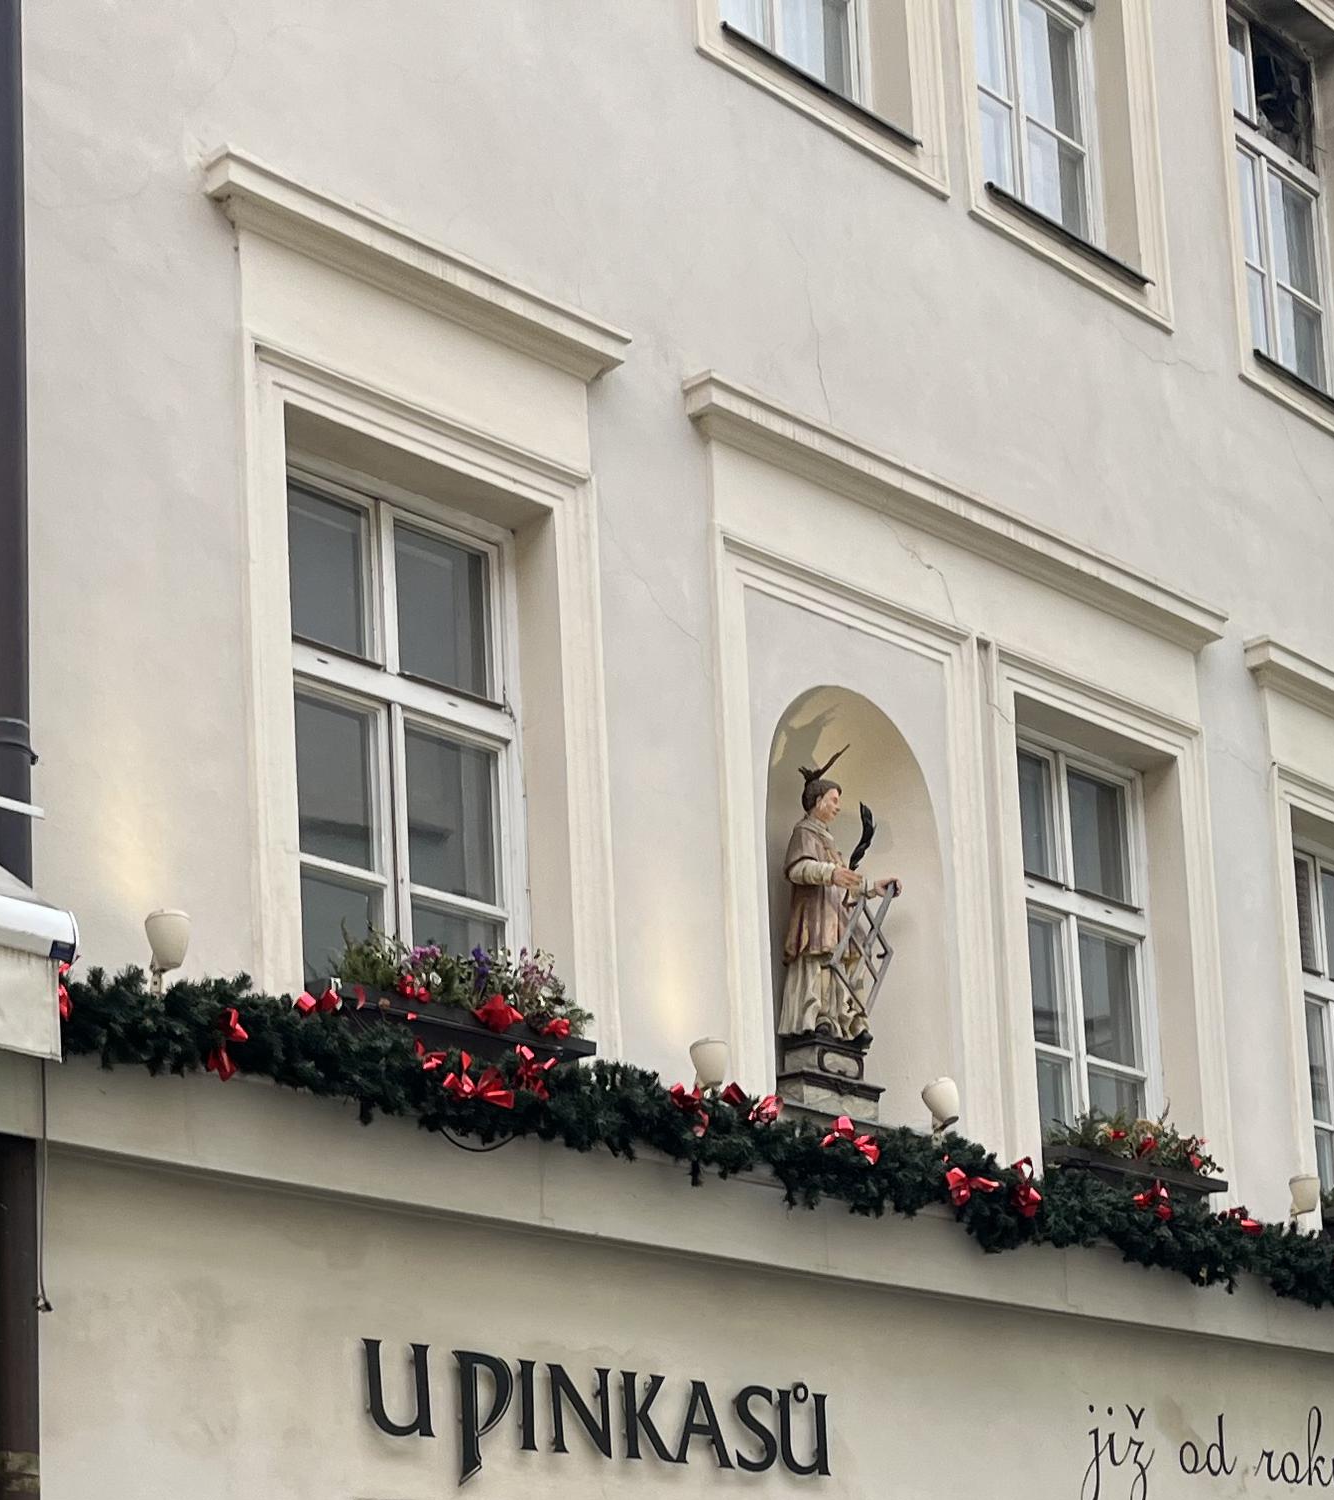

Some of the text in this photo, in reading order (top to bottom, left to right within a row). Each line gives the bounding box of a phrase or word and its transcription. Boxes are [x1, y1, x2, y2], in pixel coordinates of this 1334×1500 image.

[361, 1338, 832, 1488] U PINKASŮ
[1178, 1413, 1237, 1479] od
